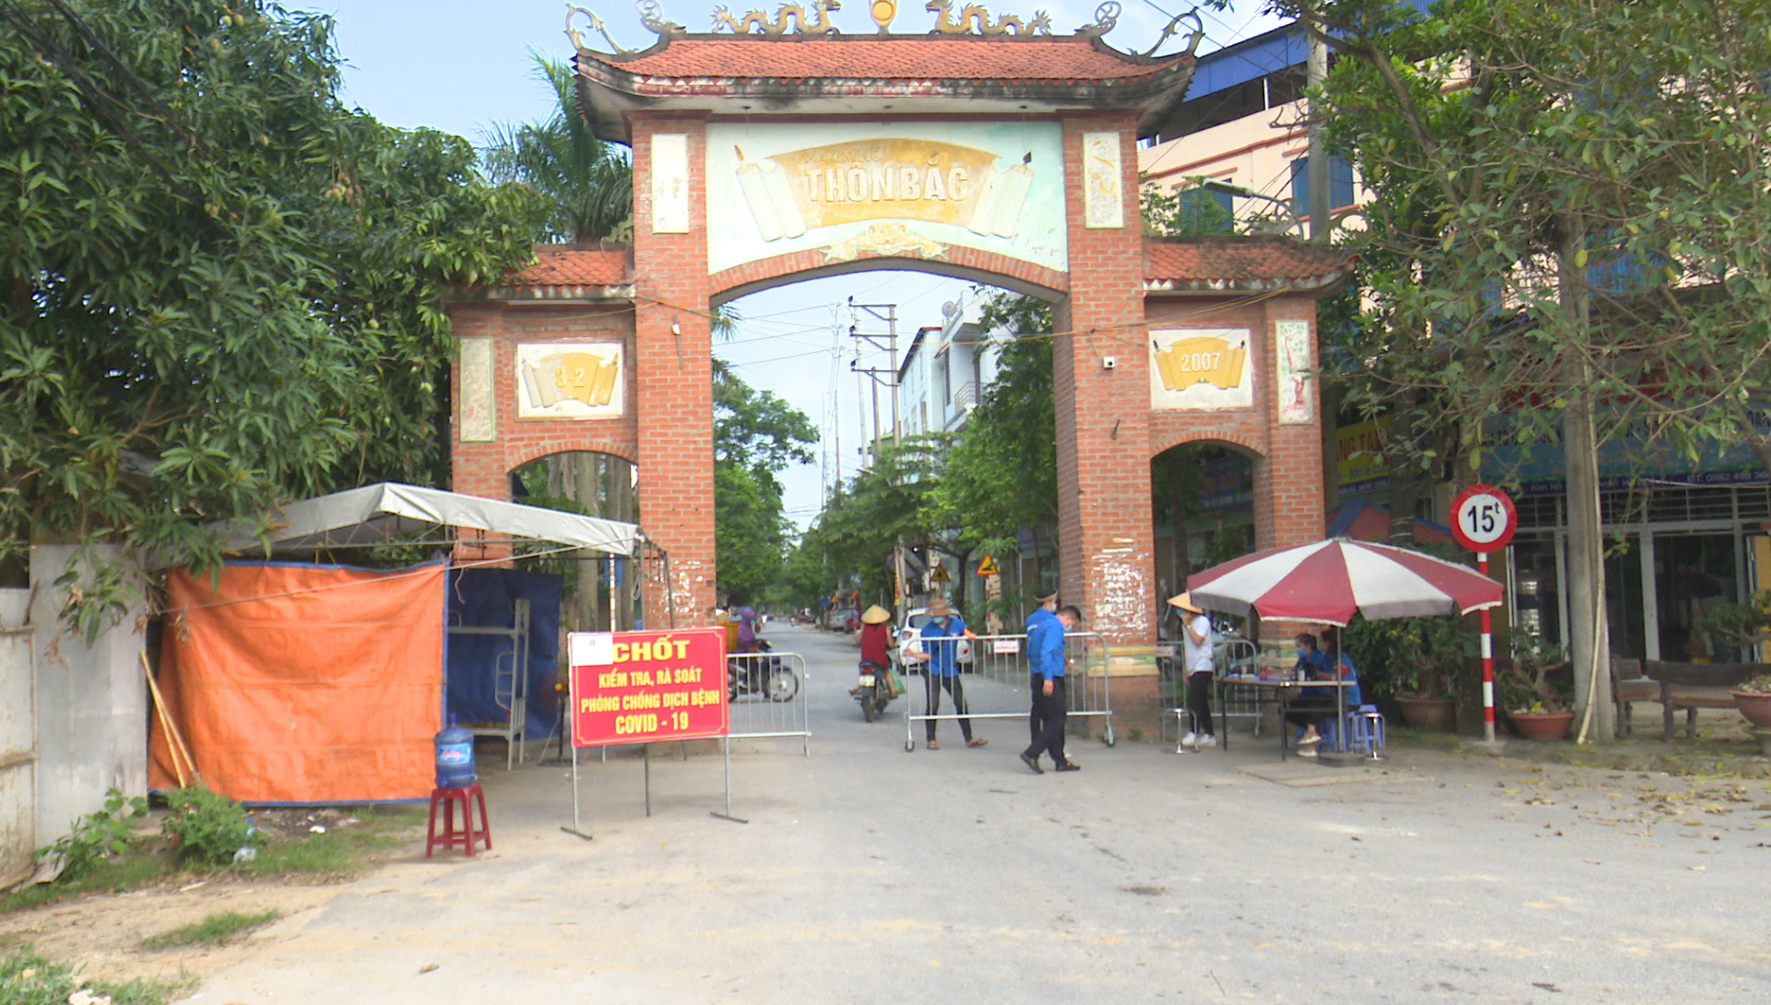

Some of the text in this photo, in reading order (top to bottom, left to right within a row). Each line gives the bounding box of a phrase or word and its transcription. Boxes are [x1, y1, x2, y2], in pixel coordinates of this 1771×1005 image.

[804, 151, 971, 203] THÔN BẮC
[1180, 352, 1221, 373] 2007
[555, 367, 585, 389] 3-2
[613, 635, 691, 663] CHỐT
[598, 667, 702, 688] KIỂM TRA, RÀ SOÁT
[581, 690, 720, 713] PHÒNG CHỐNG DỊCH BỆNH
[615, 714, 658, 735] COVID
[671, 711, 689, 731] 19
